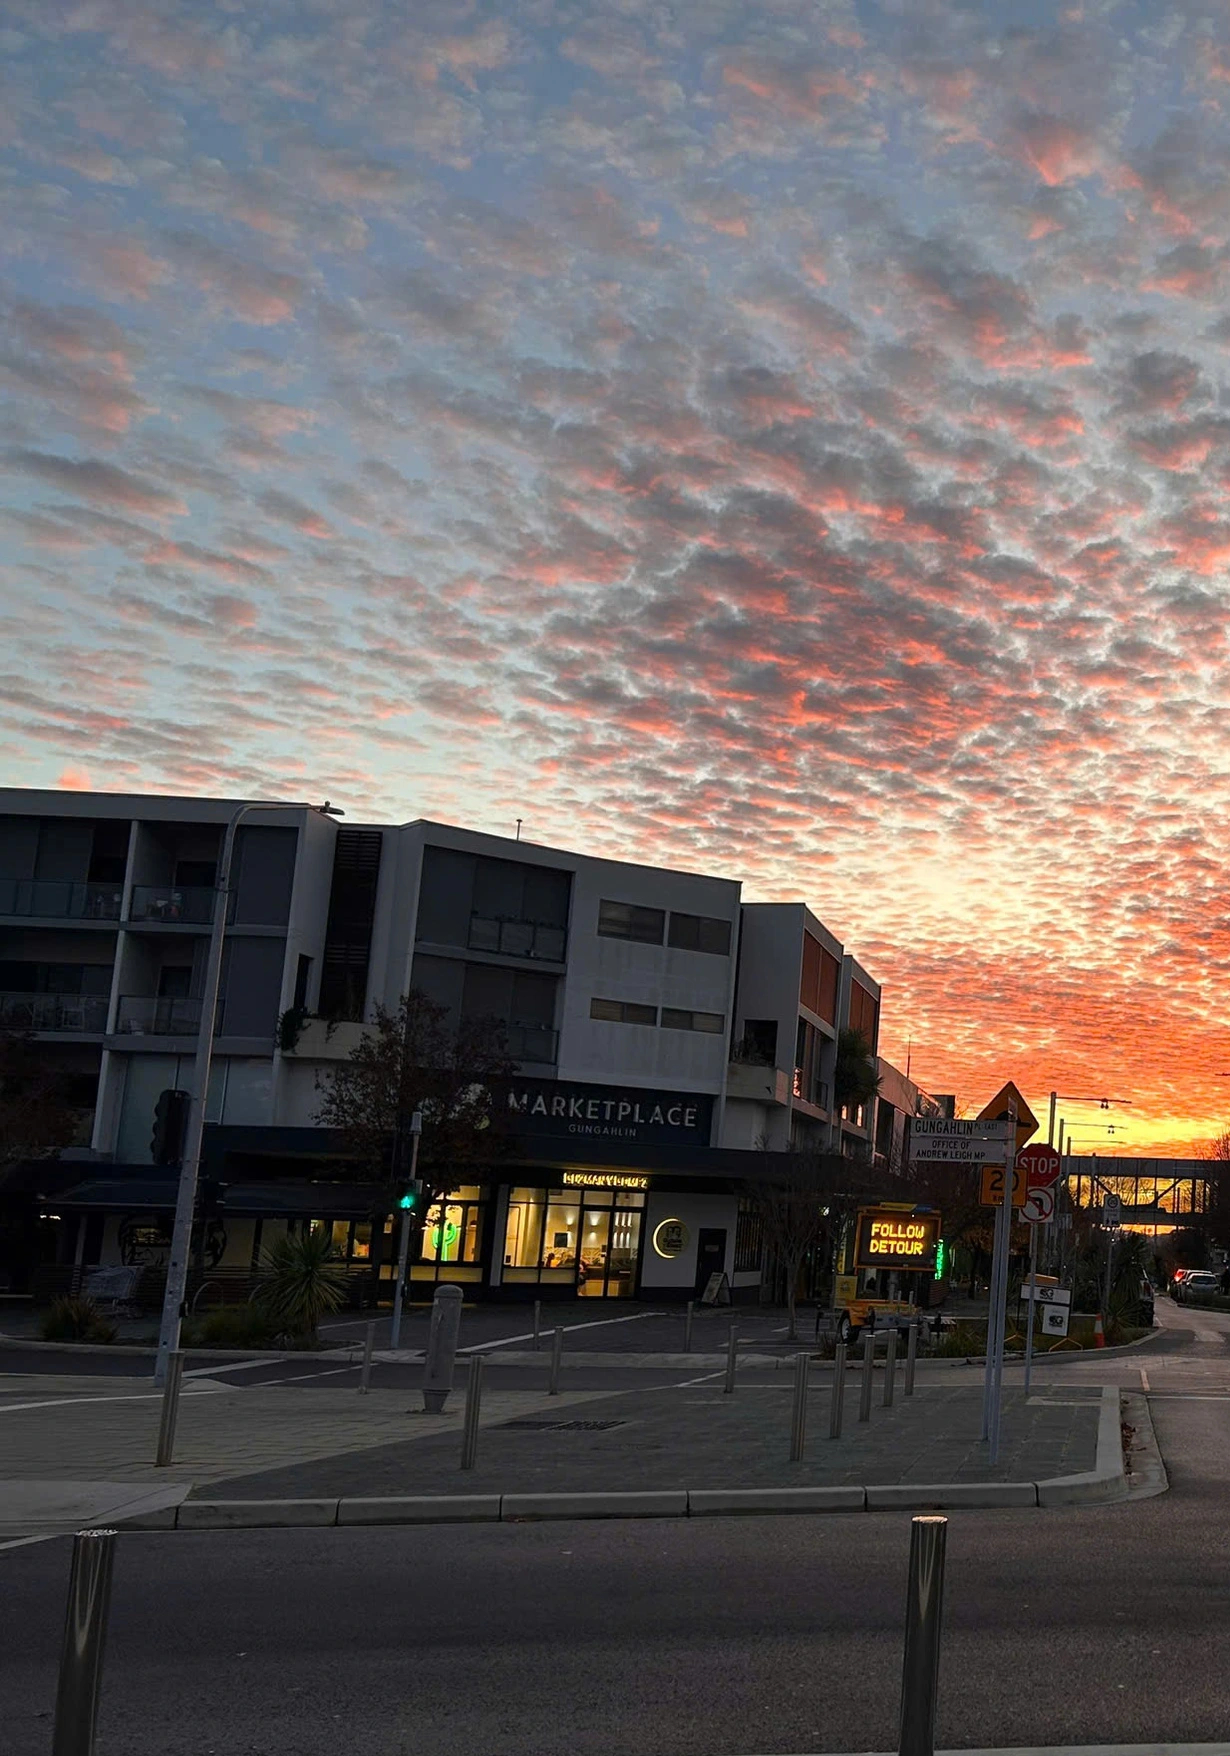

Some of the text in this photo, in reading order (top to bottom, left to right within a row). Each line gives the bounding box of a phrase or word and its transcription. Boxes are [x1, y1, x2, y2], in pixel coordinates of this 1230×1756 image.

[507, 1091, 697, 1127] MARKETPLACE
[568, 1123, 637, 1137] GUNGAHLIN
[915, 1120, 973, 1135] GUNGAHLIN
[932, 1140, 971, 1150] OFFICE OF
[916, 1149, 986, 1160] ANDREW LEIGH MP
[1020, 1157, 1059, 1175] STOP
[871, 1223, 925, 1239] FOLLOW
[869, 1239, 924, 1256] DETOUR
